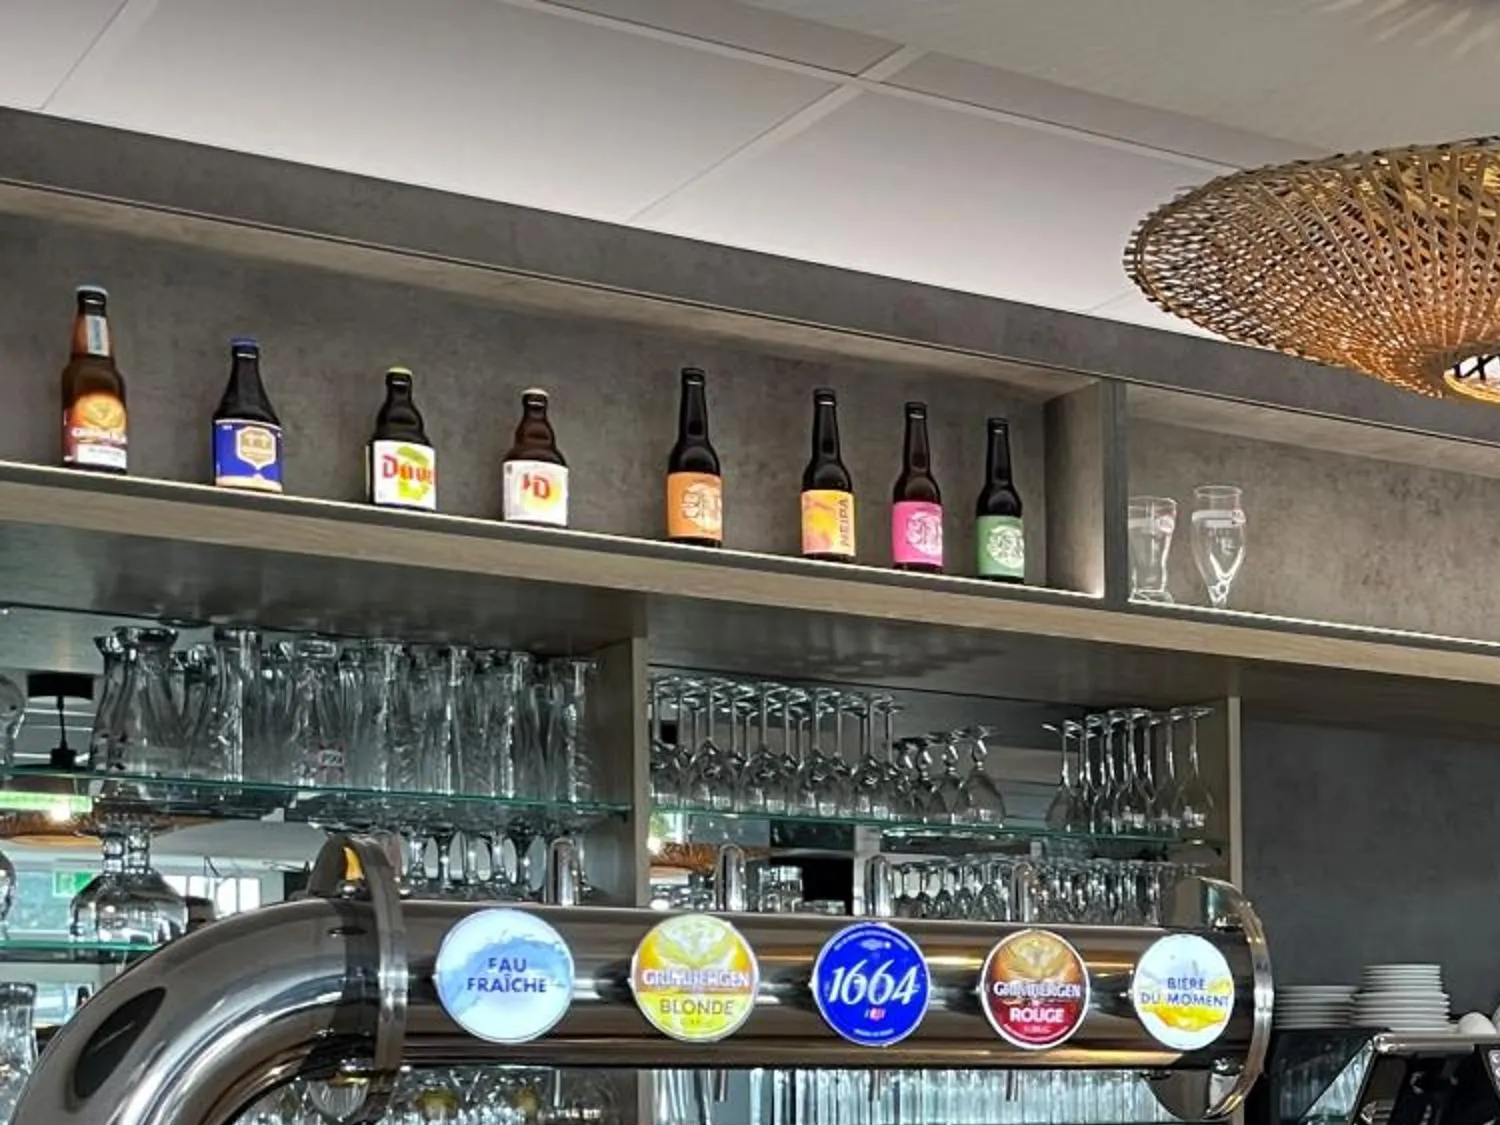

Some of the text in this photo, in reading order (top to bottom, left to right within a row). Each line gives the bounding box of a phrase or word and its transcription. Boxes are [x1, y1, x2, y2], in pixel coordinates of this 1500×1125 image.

[487, 957, 527, 973] EAU
[467, 974, 547, 993] FRAÎCHE
[828, 959, 920, 1005] 1664
[659, 998, 735, 1015] BLONDE
[1141, 992, 1229, 1008] DU MOMENT
[1009, 1007, 1065, 1023] ROUGE
